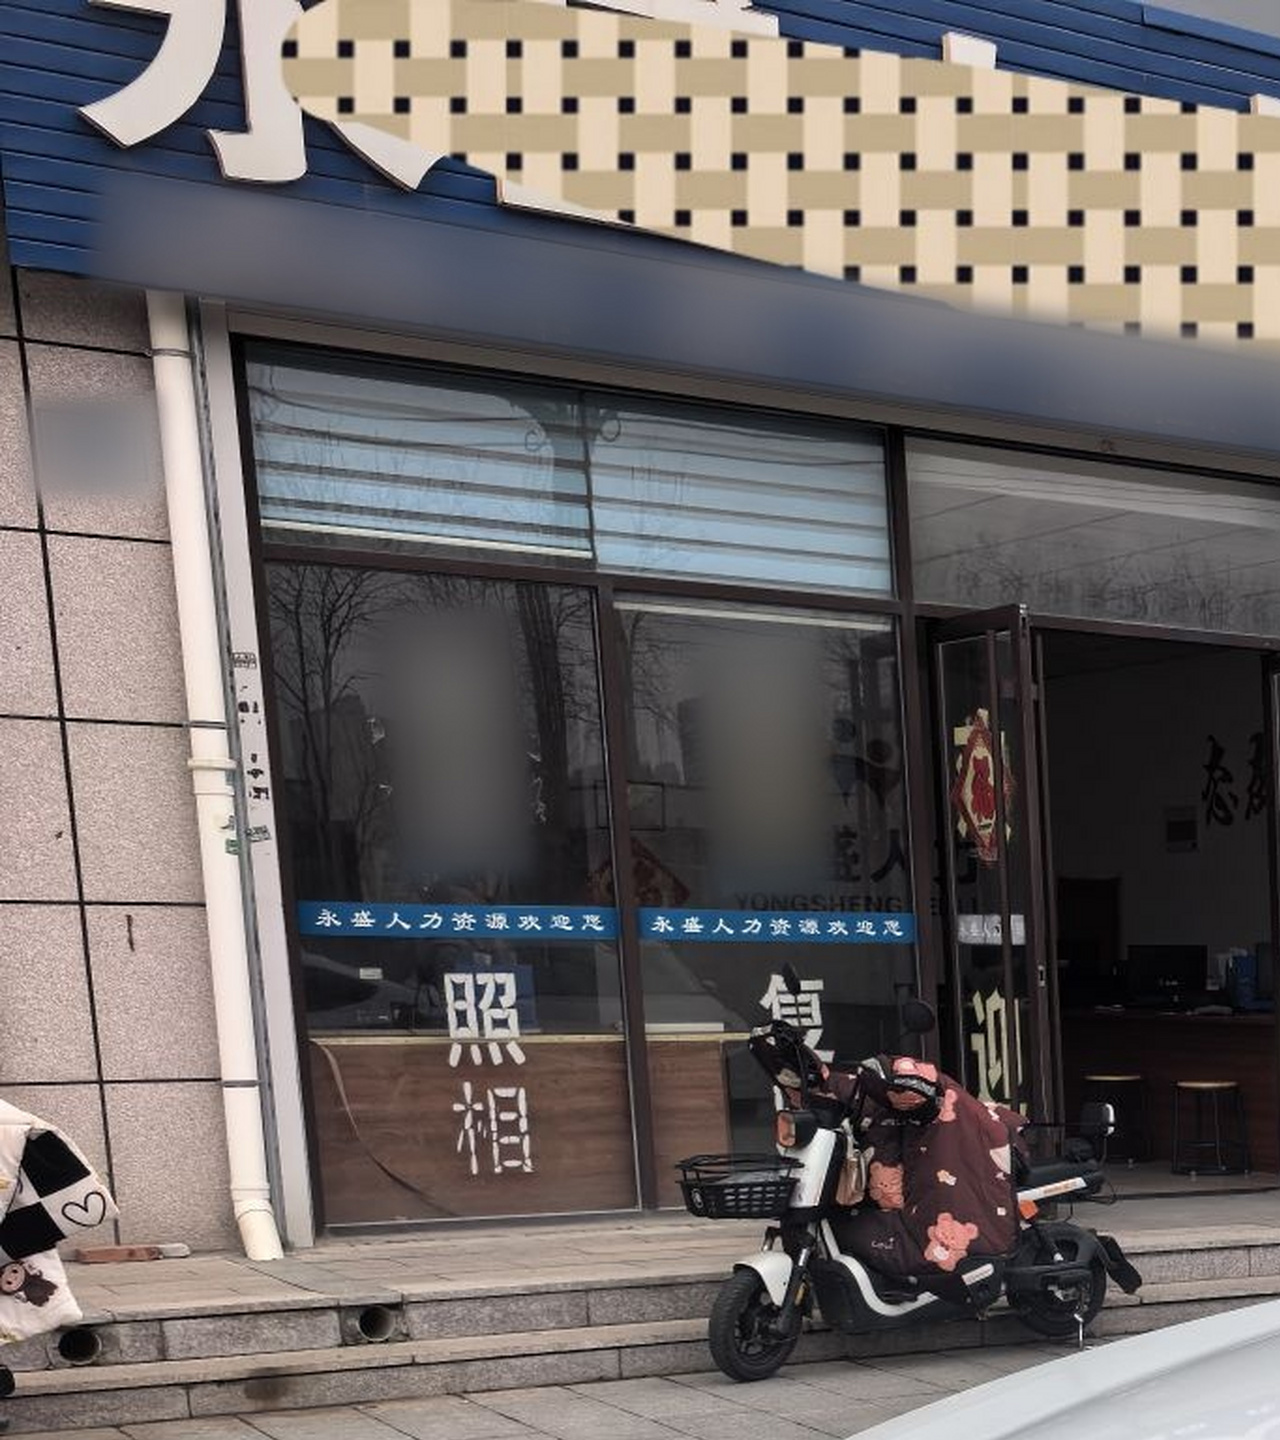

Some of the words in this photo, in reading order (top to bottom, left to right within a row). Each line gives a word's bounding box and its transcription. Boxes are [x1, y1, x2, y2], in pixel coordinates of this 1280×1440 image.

[315, 908, 606, 932] 永盛人力资源欢迎您
[651, 915, 905, 938] 永盛人力资源欢迎您
[444, 971, 535, 1176] 照相
